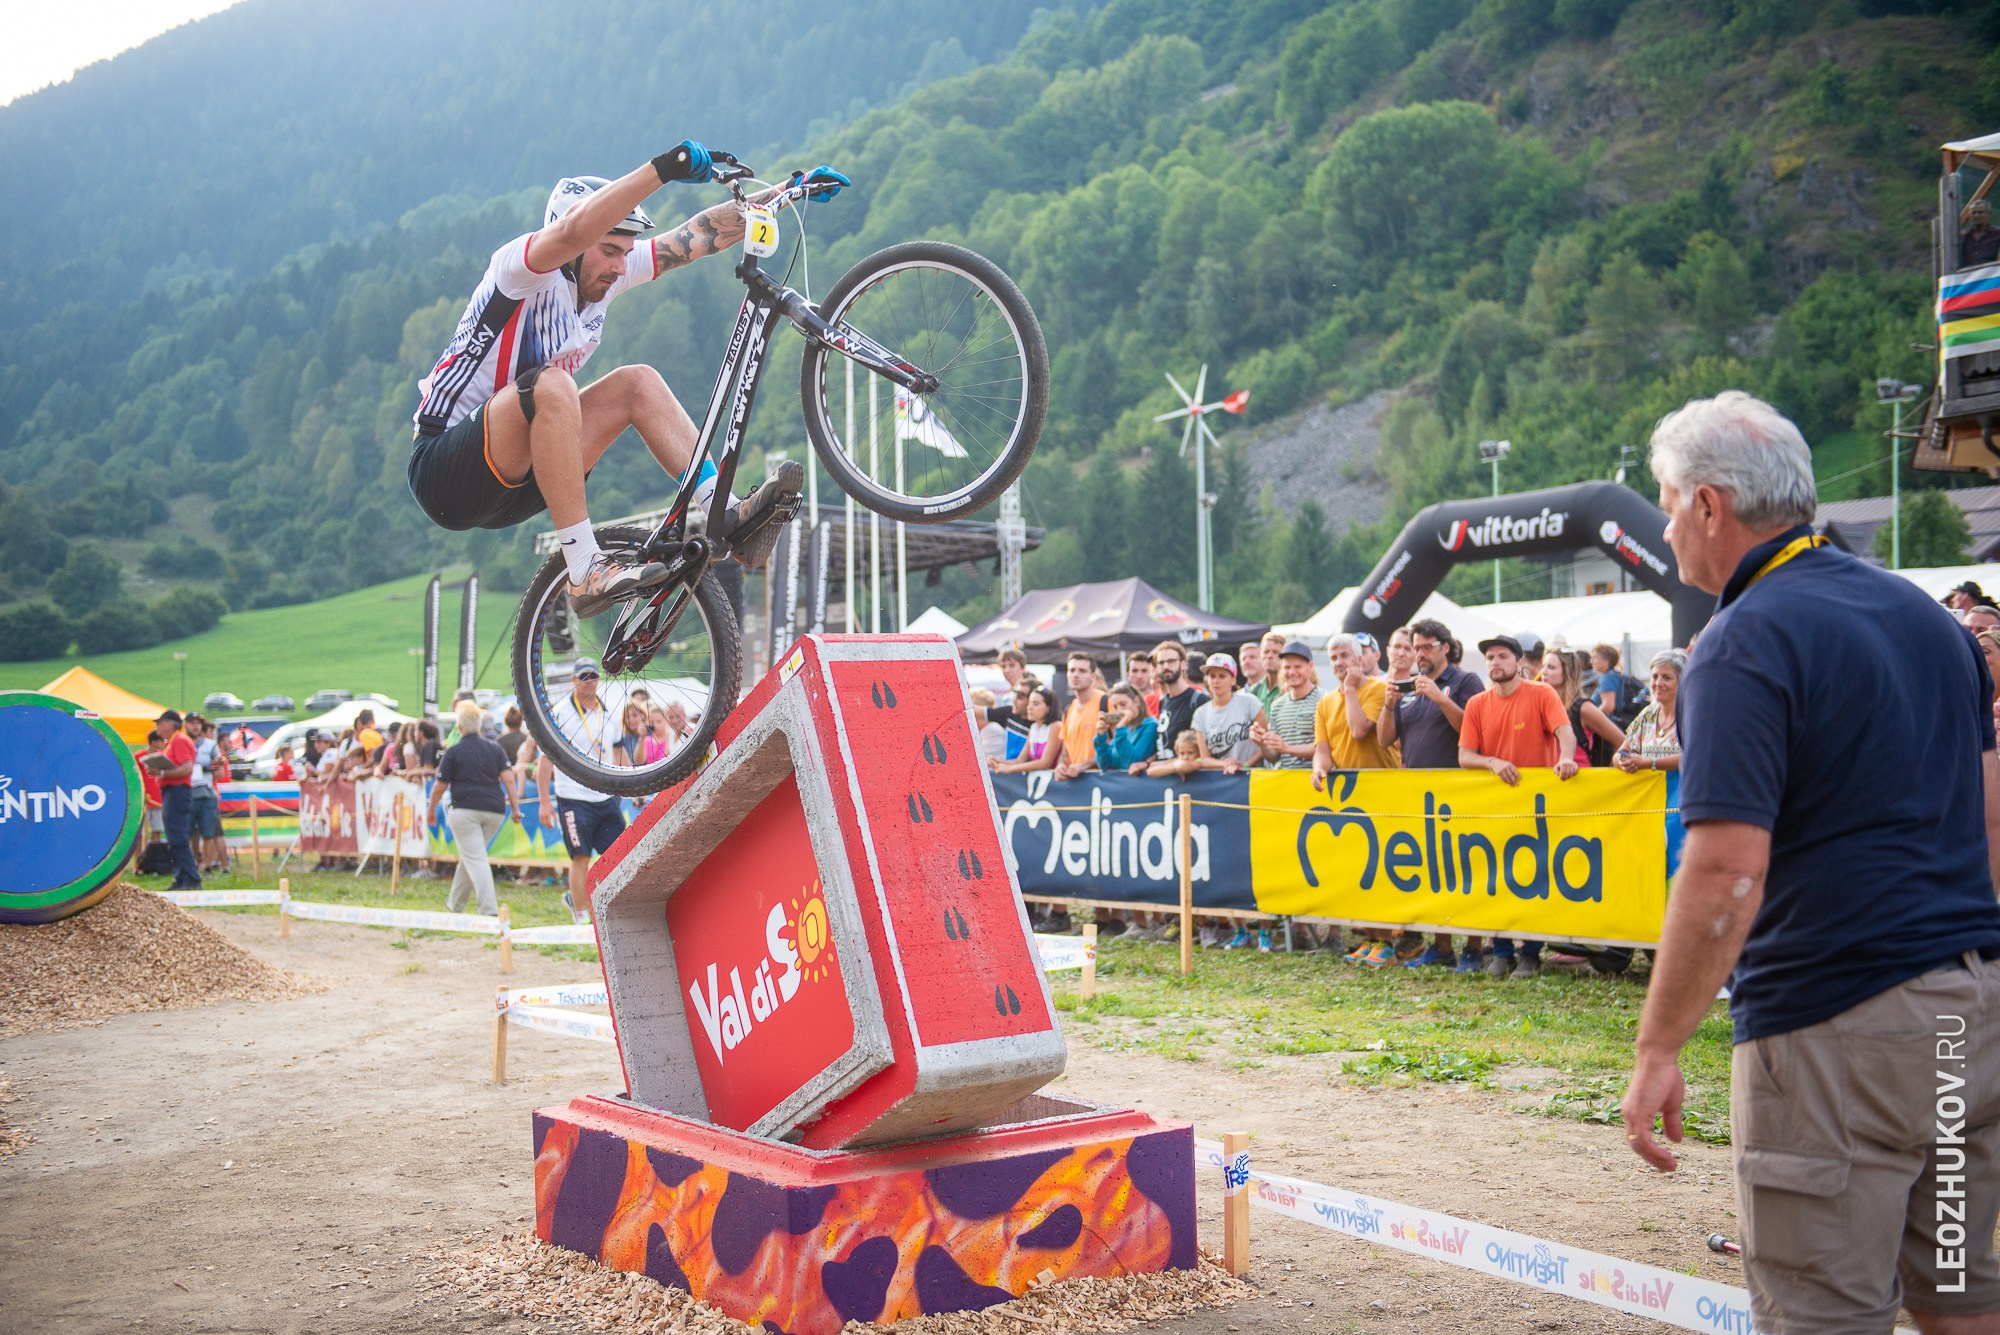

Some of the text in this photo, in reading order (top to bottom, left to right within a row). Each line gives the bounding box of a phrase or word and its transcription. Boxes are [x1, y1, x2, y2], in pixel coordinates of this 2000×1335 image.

[758, 225, 767, 244] 2
[468, 323, 496, 357] sky
[727, 308, 751, 372] JEALOUSY
[1467, 507, 1564, 547] vittoria
[1004, 786, 1210, 882] Melinda
[1297, 790, 1602, 903] Melinda
[688, 962, 753, 1067] Val
[751, 956, 779, 1023] di
